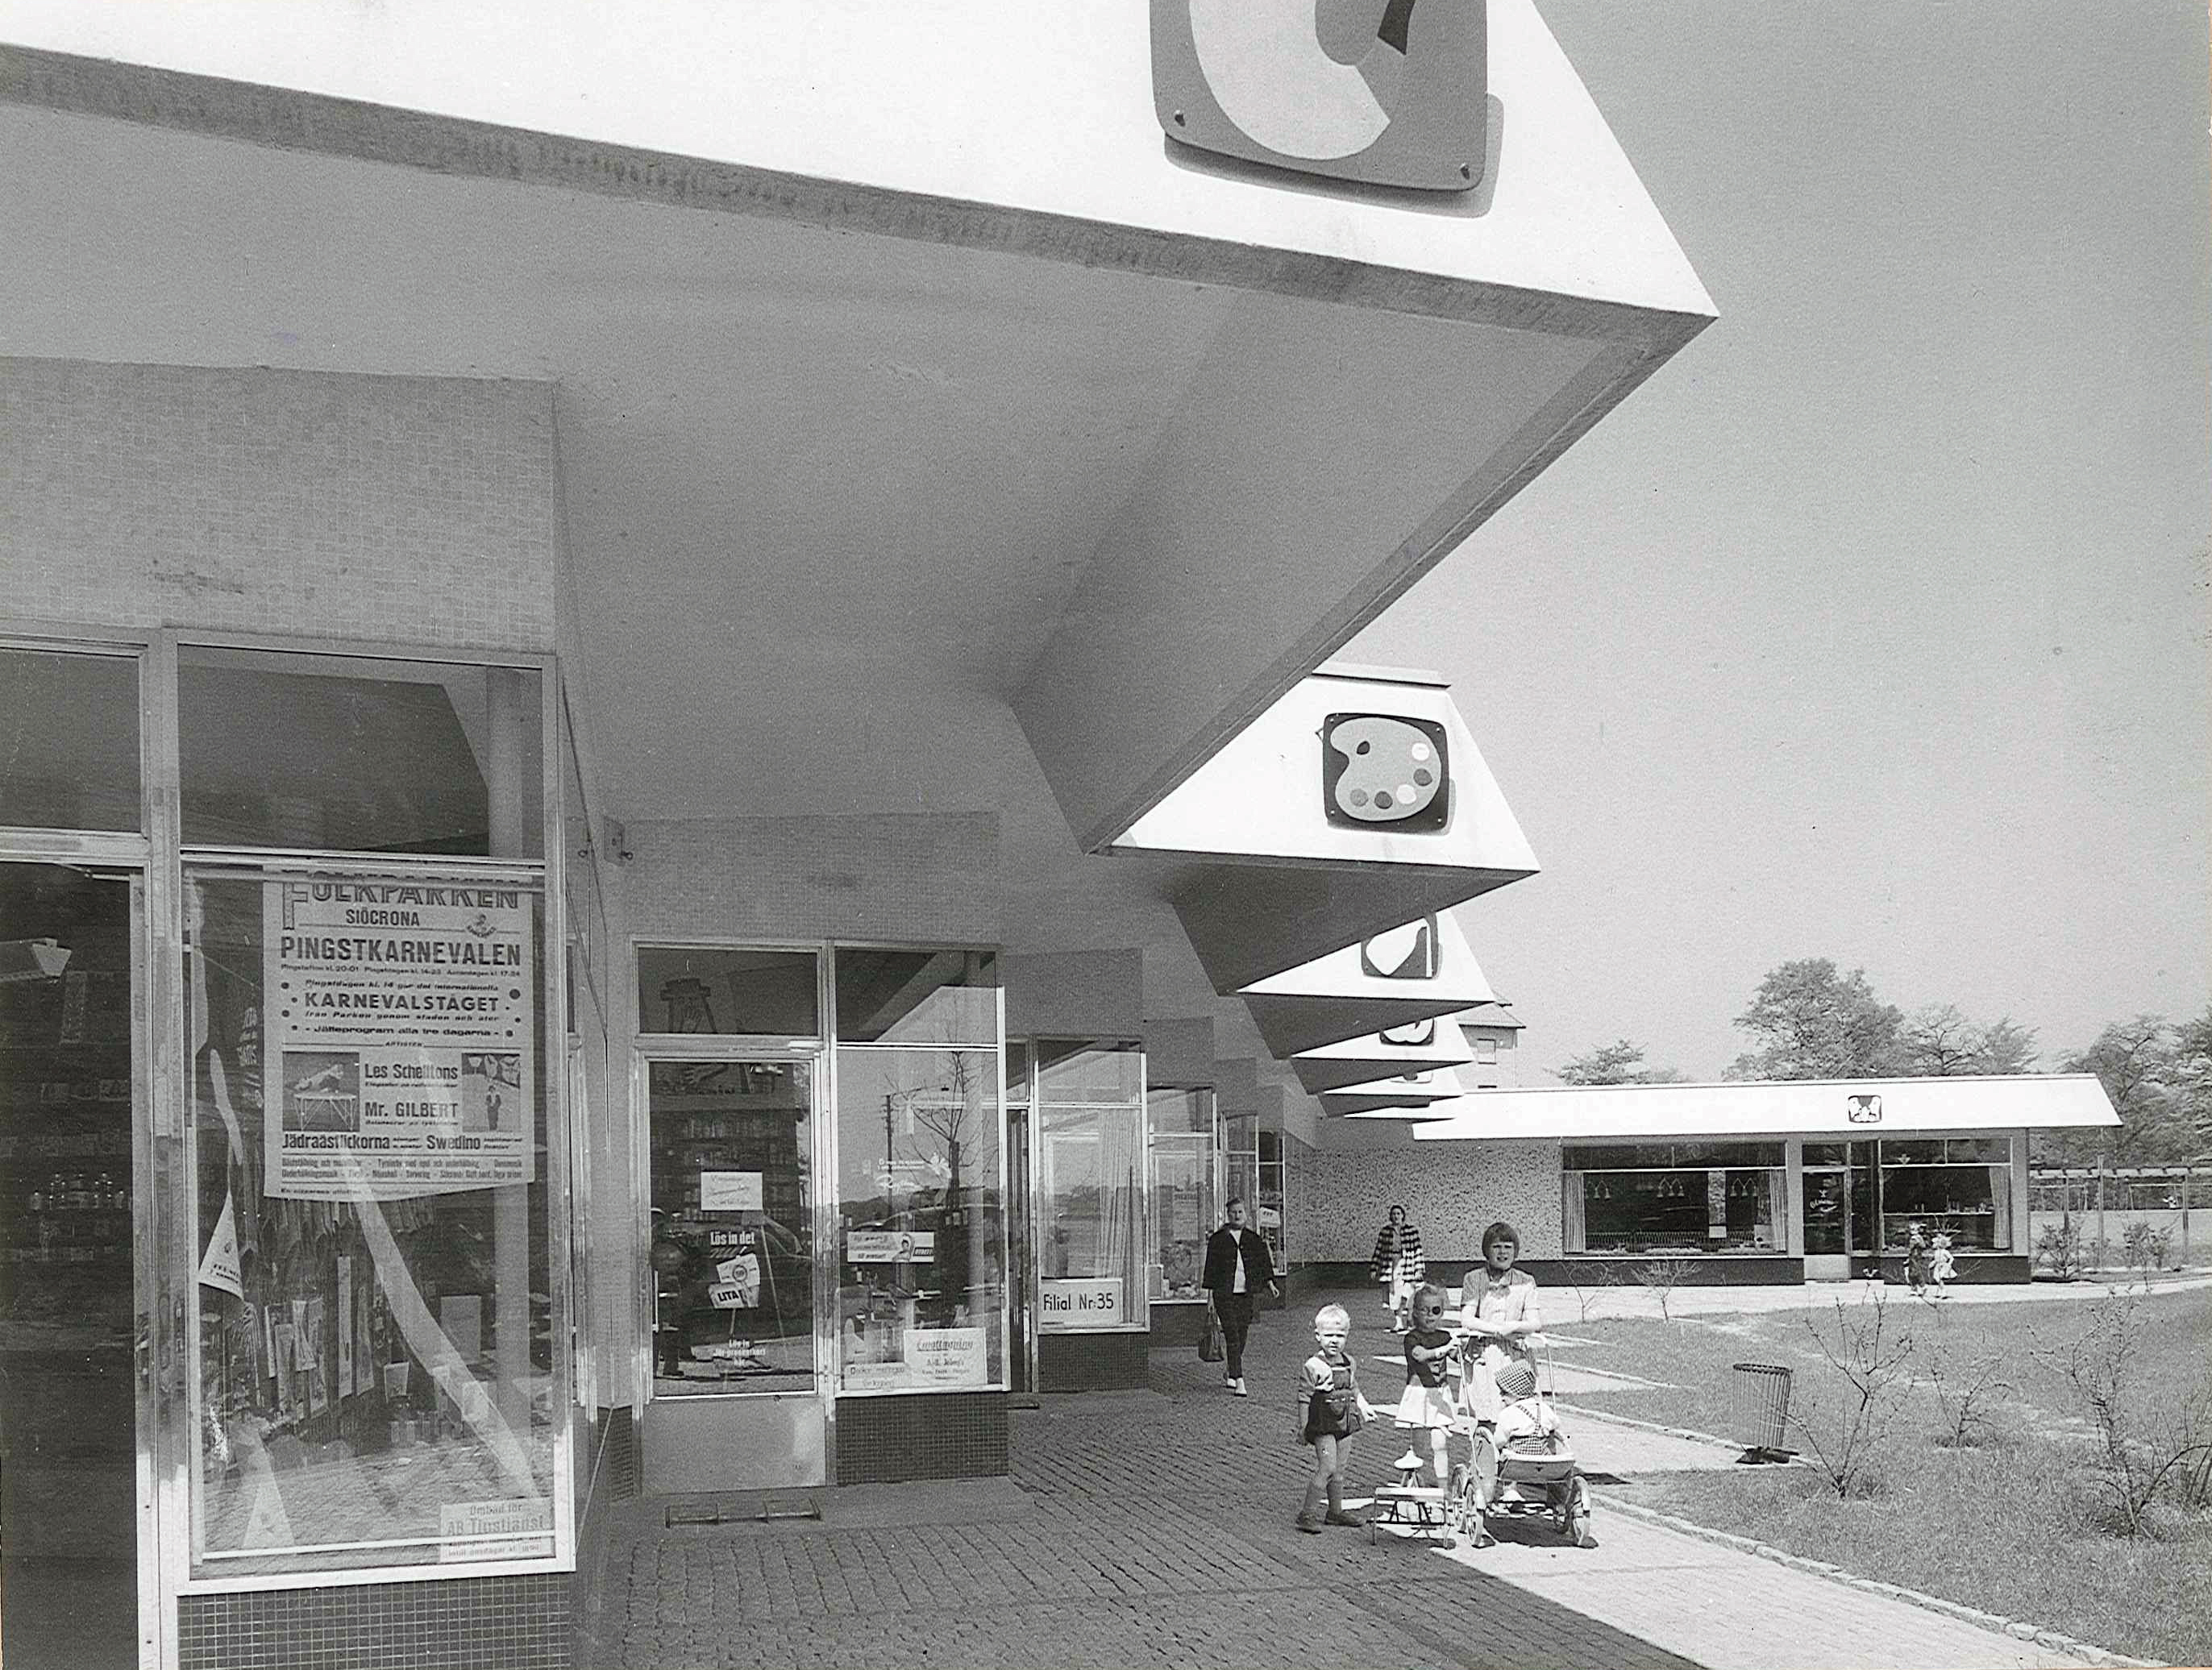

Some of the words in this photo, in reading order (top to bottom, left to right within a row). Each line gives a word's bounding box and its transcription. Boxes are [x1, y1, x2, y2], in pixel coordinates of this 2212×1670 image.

[281, 936, 521, 966] PINGSTKARNEVALEN
[364, 1063, 388, 1078] Les
[365, 1102, 388, 1117] Mr.
[395, 1102, 459, 1118] GILBERT
[710, 1231, 727, 1246] Lös
[728, 1232, 738, 1246] in
[739, 1231, 755, 1245] det
[1043, 1293, 1071, 1311] Filial
